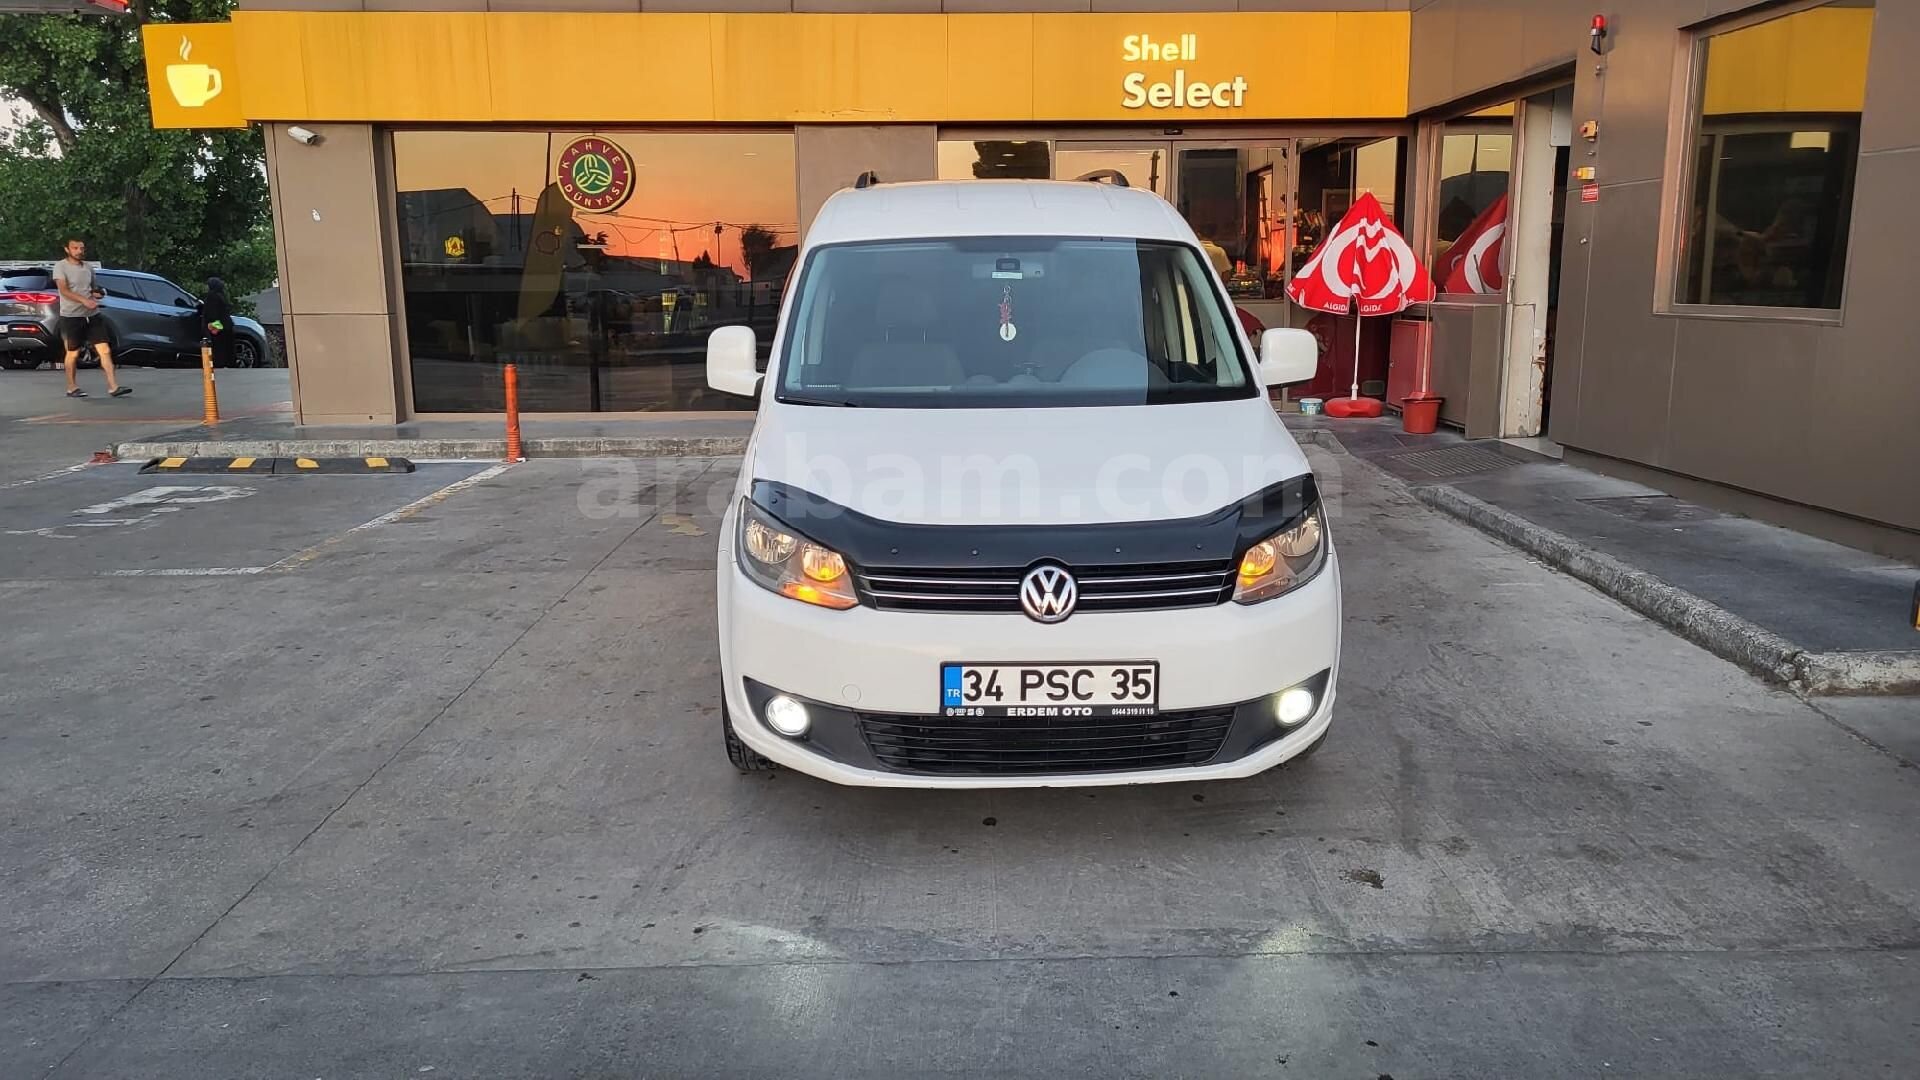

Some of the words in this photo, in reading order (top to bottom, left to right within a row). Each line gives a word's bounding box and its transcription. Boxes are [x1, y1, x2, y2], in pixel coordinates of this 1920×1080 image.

[1122, 34, 1196, 61] Shell
[1121, 69, 1248, 108] Select
[561, 141, 621, 169] KAHVE
[564, 180, 624, 207] DÜNYASI
[947, 688, 961, 698] TR
[963, 669, 1004, 702] 34
[1020, 669, 1095, 701] PSC
[1111, 668, 1153, 701] 35
[1007, 707, 1058, 717] ERDEM
[1062, 706, 1093, 717] OTO
